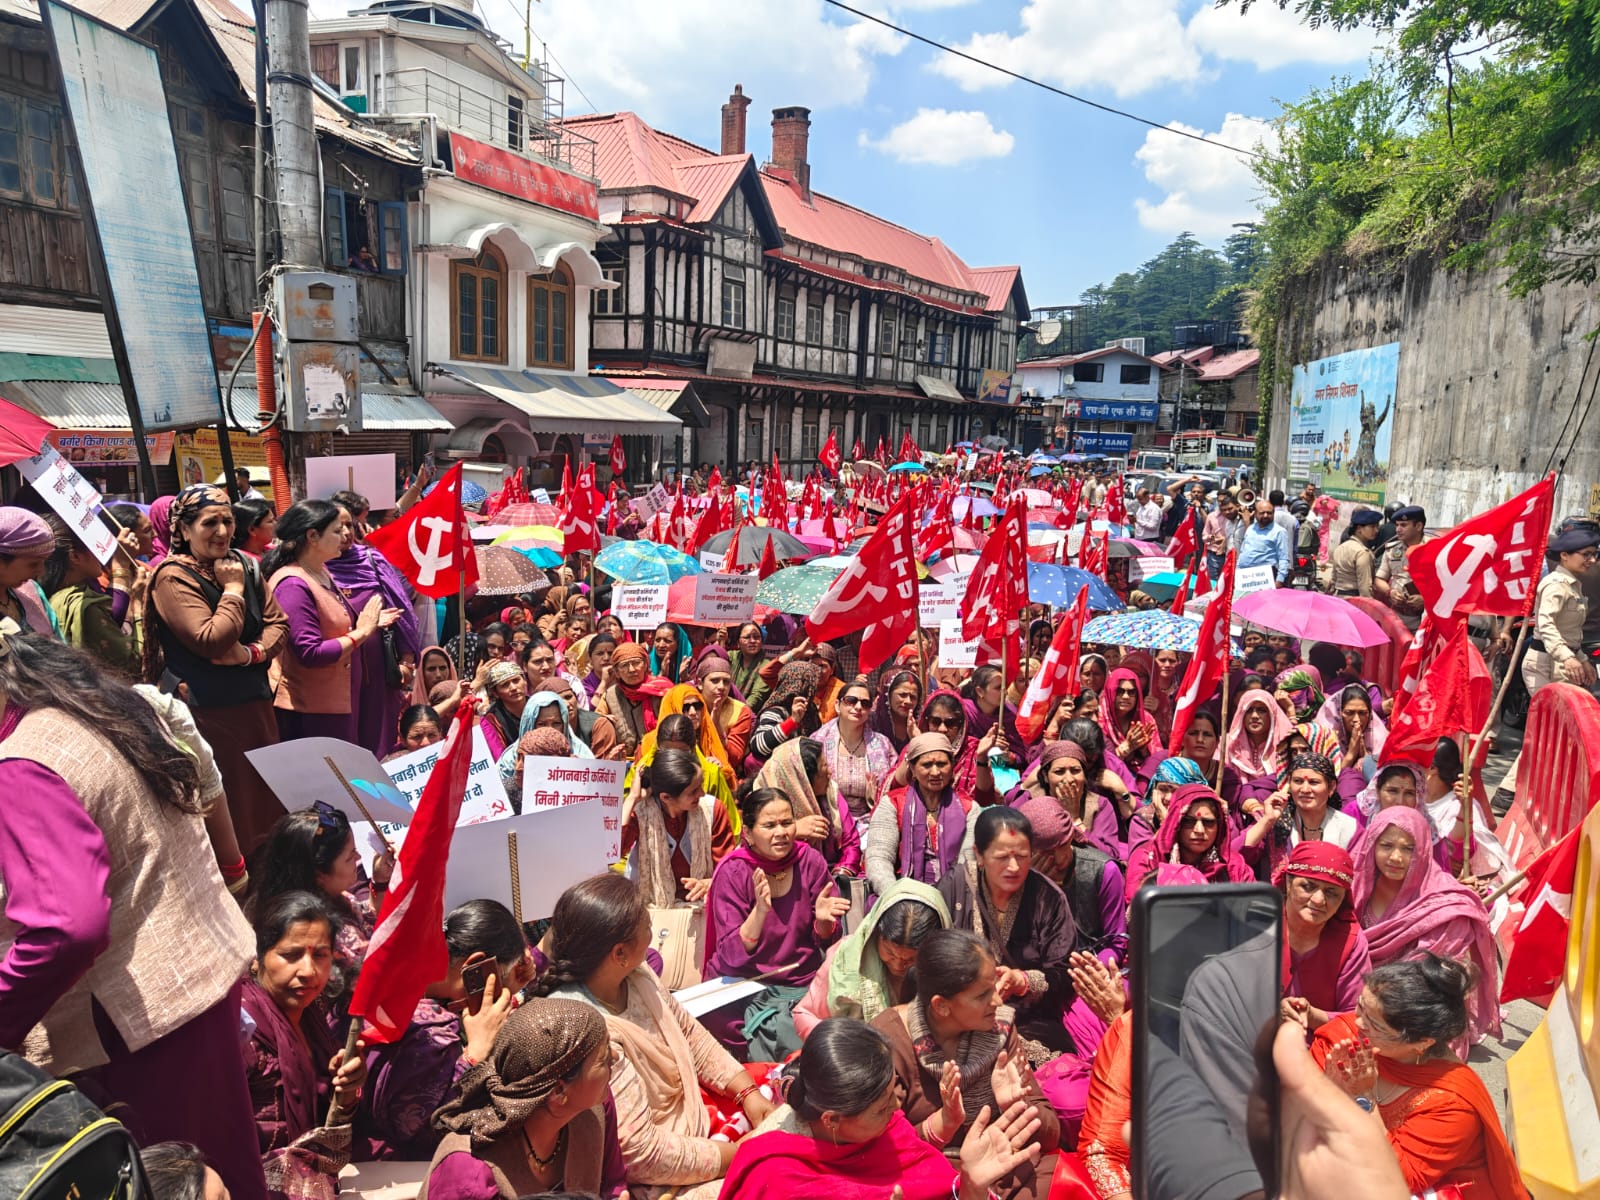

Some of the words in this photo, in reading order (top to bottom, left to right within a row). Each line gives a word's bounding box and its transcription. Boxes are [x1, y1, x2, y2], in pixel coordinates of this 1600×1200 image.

[59, 434, 82, 447] बर्गर
[83, 434, 104, 447] किंग
[107, 437, 124, 447] एण्ड
[1104, 439, 1129, 447] BANK
[547, 765, 590, 786] आंगनबाड़ी
[591, 767, 610, 783] कर्मियों
[472, 783, 484, 796] दो
[534, 790, 560, 807] मिनी
